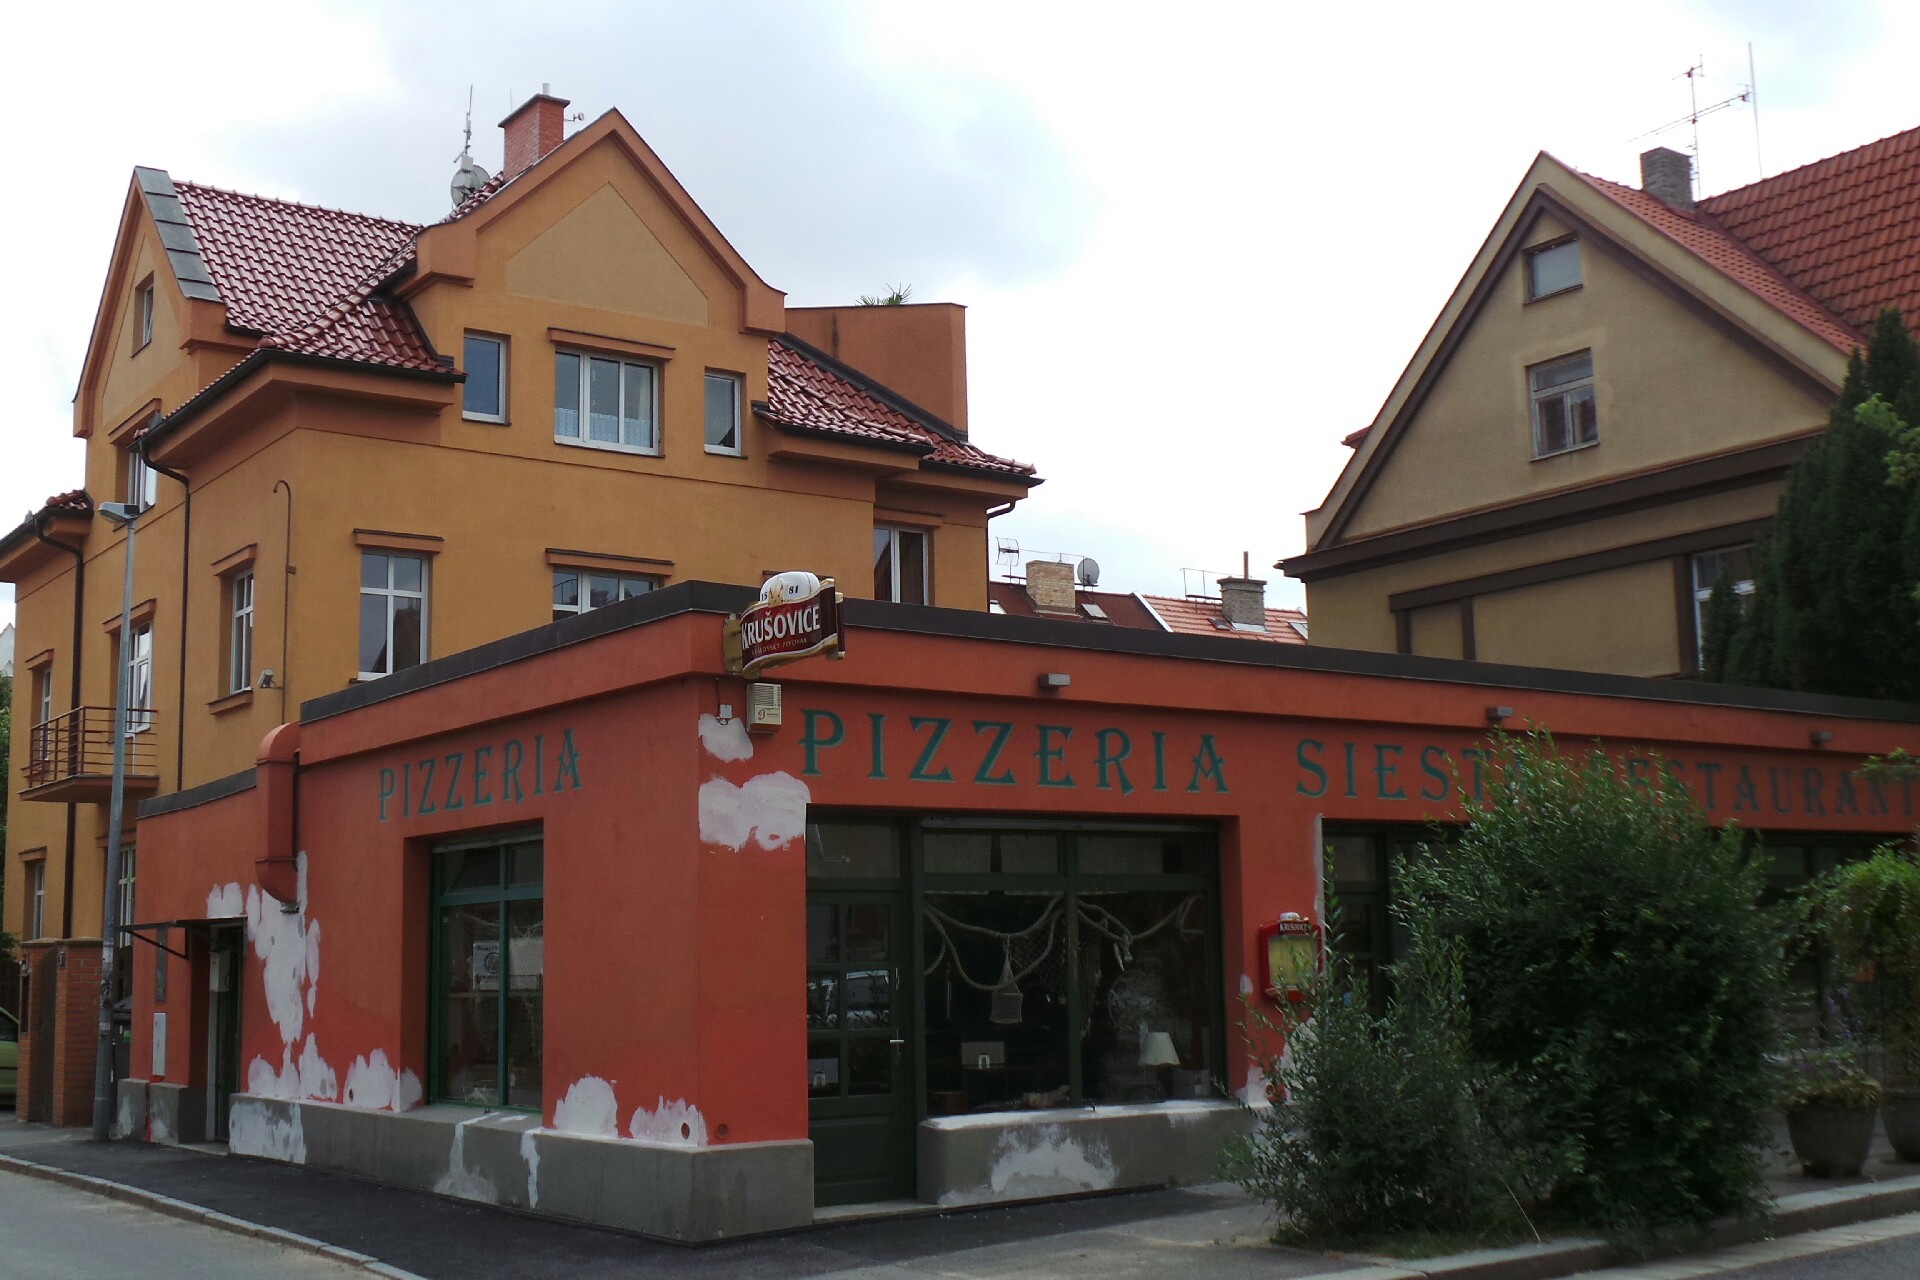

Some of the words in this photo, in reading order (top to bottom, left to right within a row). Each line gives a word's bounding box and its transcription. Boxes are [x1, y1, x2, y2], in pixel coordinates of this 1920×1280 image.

[788, 585, 799, 594] 81
[741, 604, 821, 650] KRUŠOVICE
[379, 727, 582, 823] PIZZERIA
[797, 708, 1230, 796] PIZZERIA
[1296, 739, 1537, 803] SIEST
[1590, 757, 1920, 817] ESTAURANT
